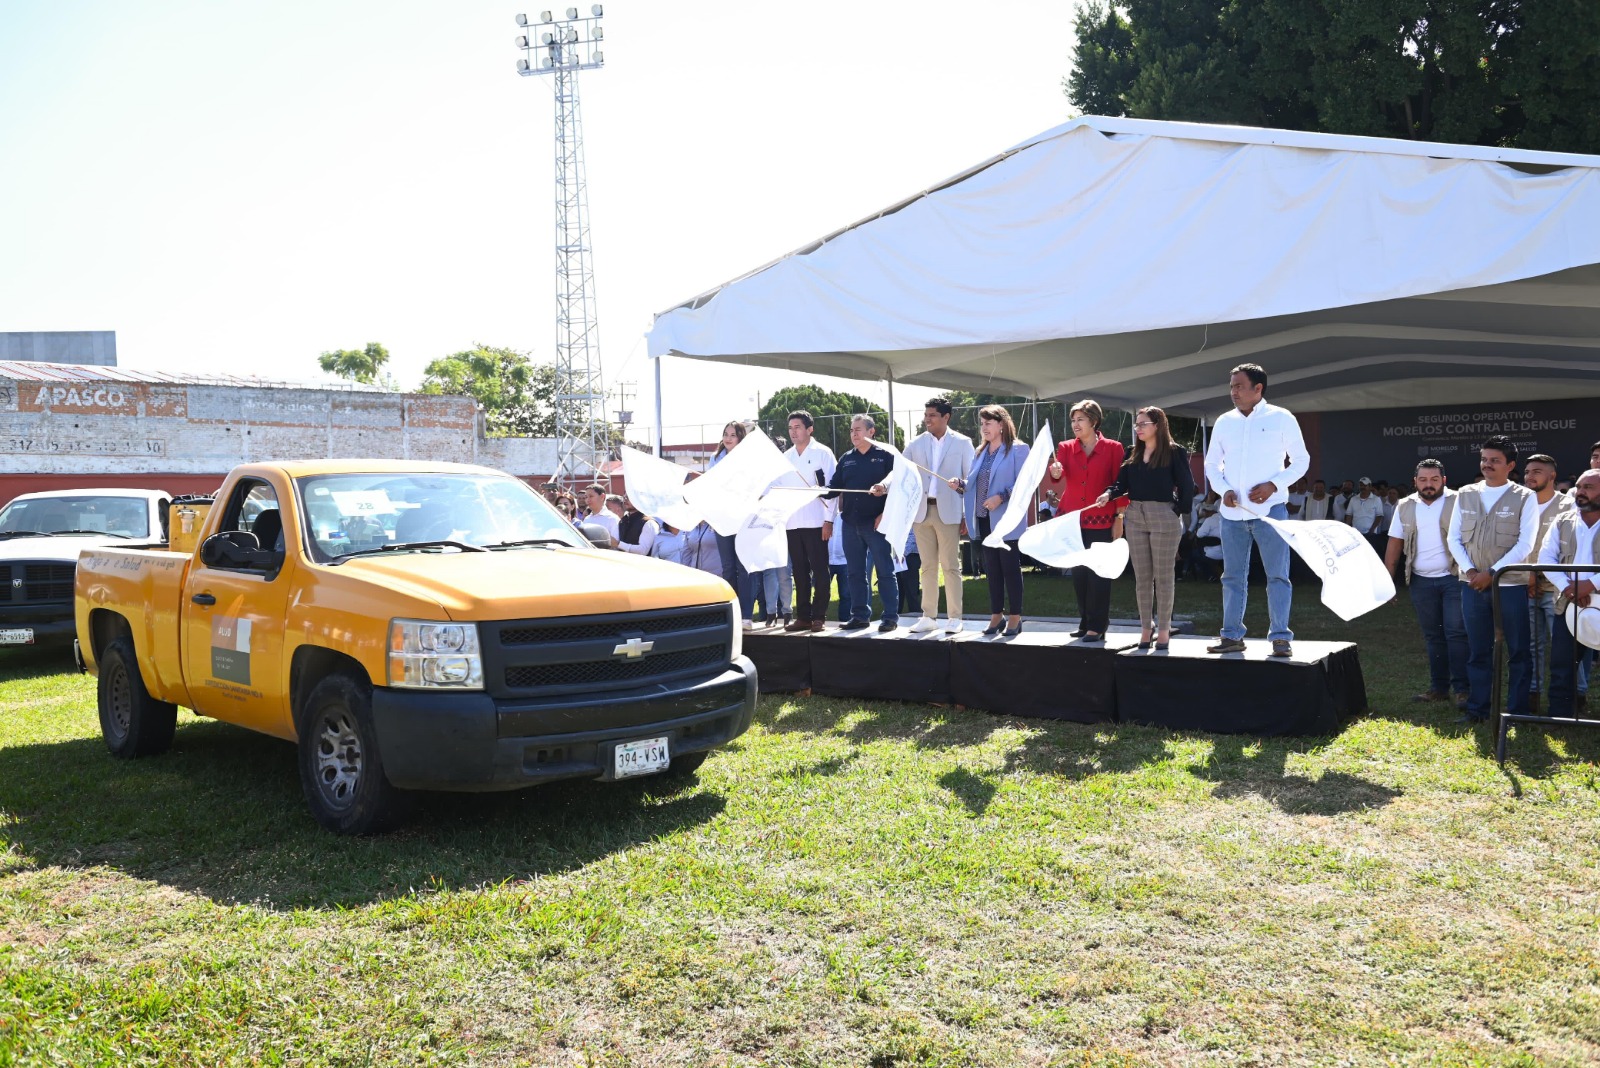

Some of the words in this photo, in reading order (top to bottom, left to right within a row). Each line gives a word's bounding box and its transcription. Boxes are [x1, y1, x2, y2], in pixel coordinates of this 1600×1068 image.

[34, 387, 124, 407] APASCO
[1418, 413, 1470, 424] SEGUNDO
[1472, 410, 1535, 421] OPERATIVO
[1383, 425, 1443, 437] MORELOS
[1445, 423, 1500, 435] CONTRA
[1503, 422, 1518, 432] EL
[1520, 419, 1577, 431] DENGUE
[356, 502, 374, 510] 28
[121, 556, 142, 571] Salud
